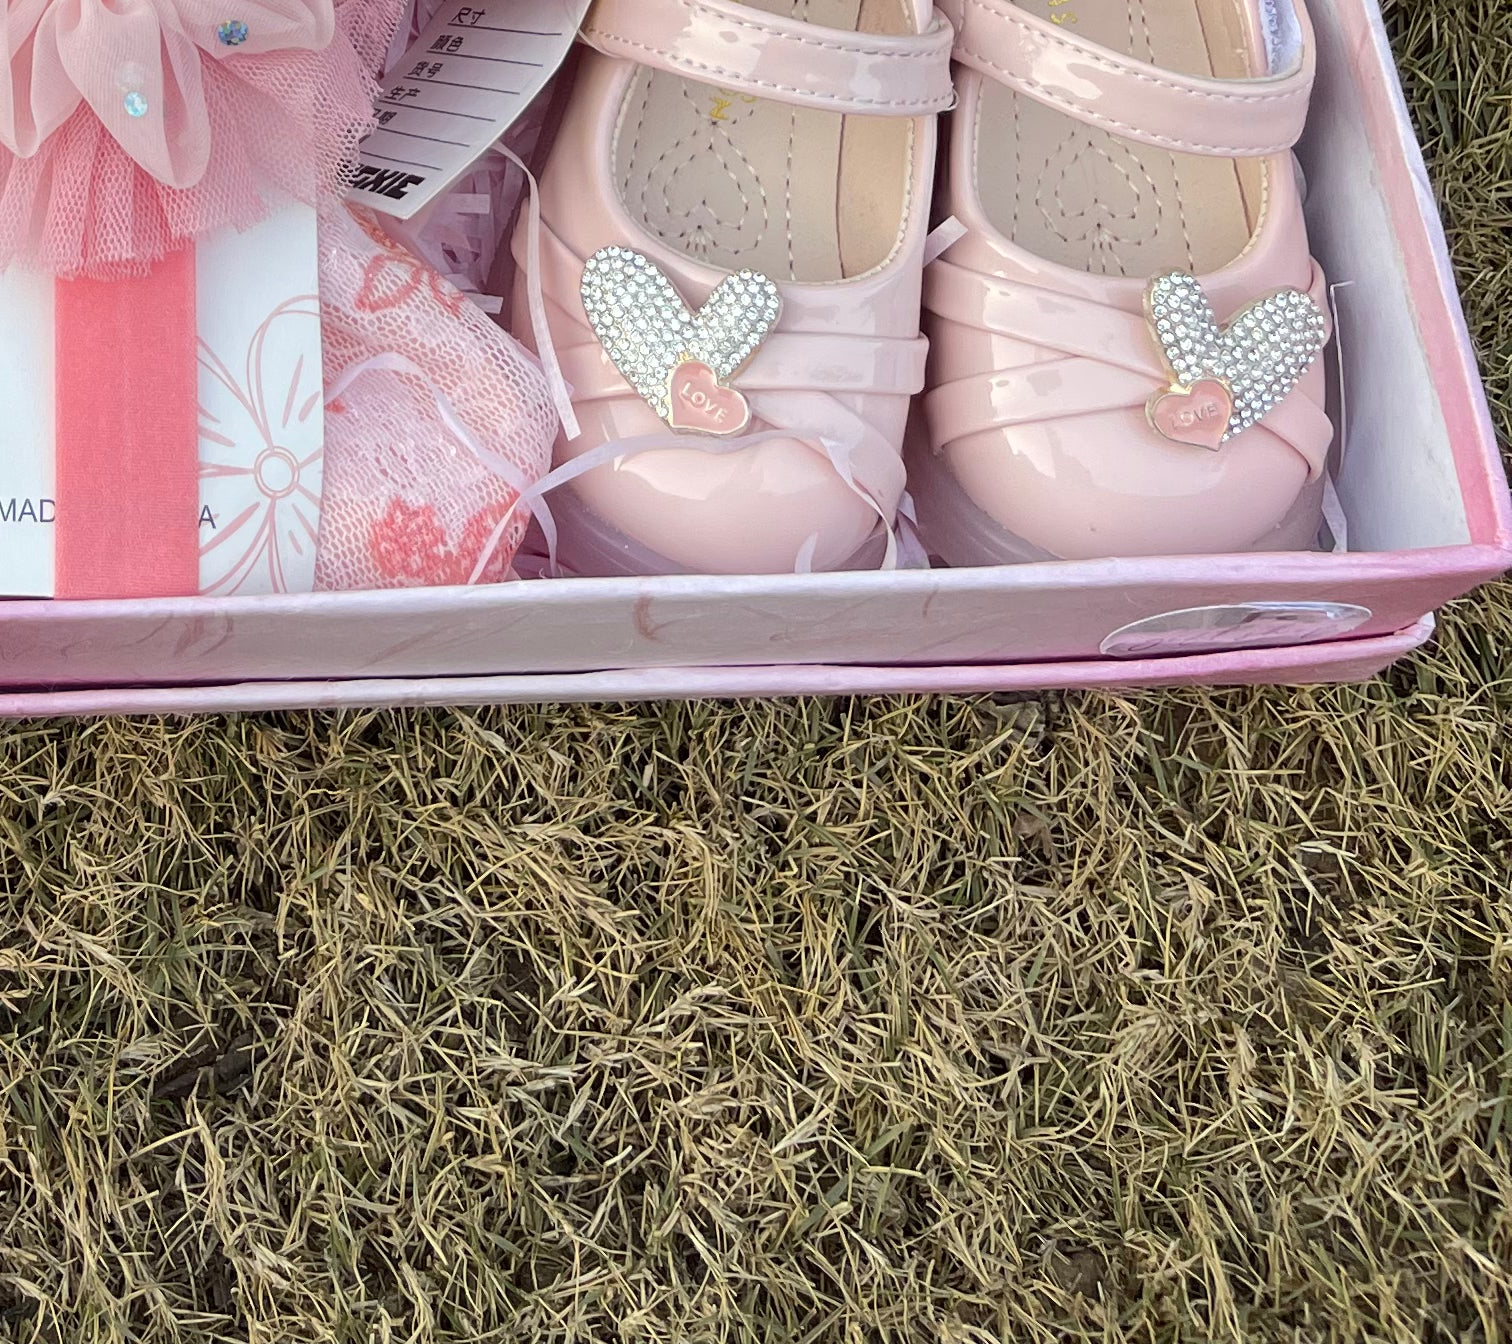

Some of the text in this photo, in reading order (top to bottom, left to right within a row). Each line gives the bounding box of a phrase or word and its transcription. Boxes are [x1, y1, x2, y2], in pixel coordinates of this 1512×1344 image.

[451, 6, 486, 26] 尺寸
[384, 86, 421, 102] 生产
[682, 382, 728, 424] LOVE
[1168, 402, 1218, 431] LOVE
